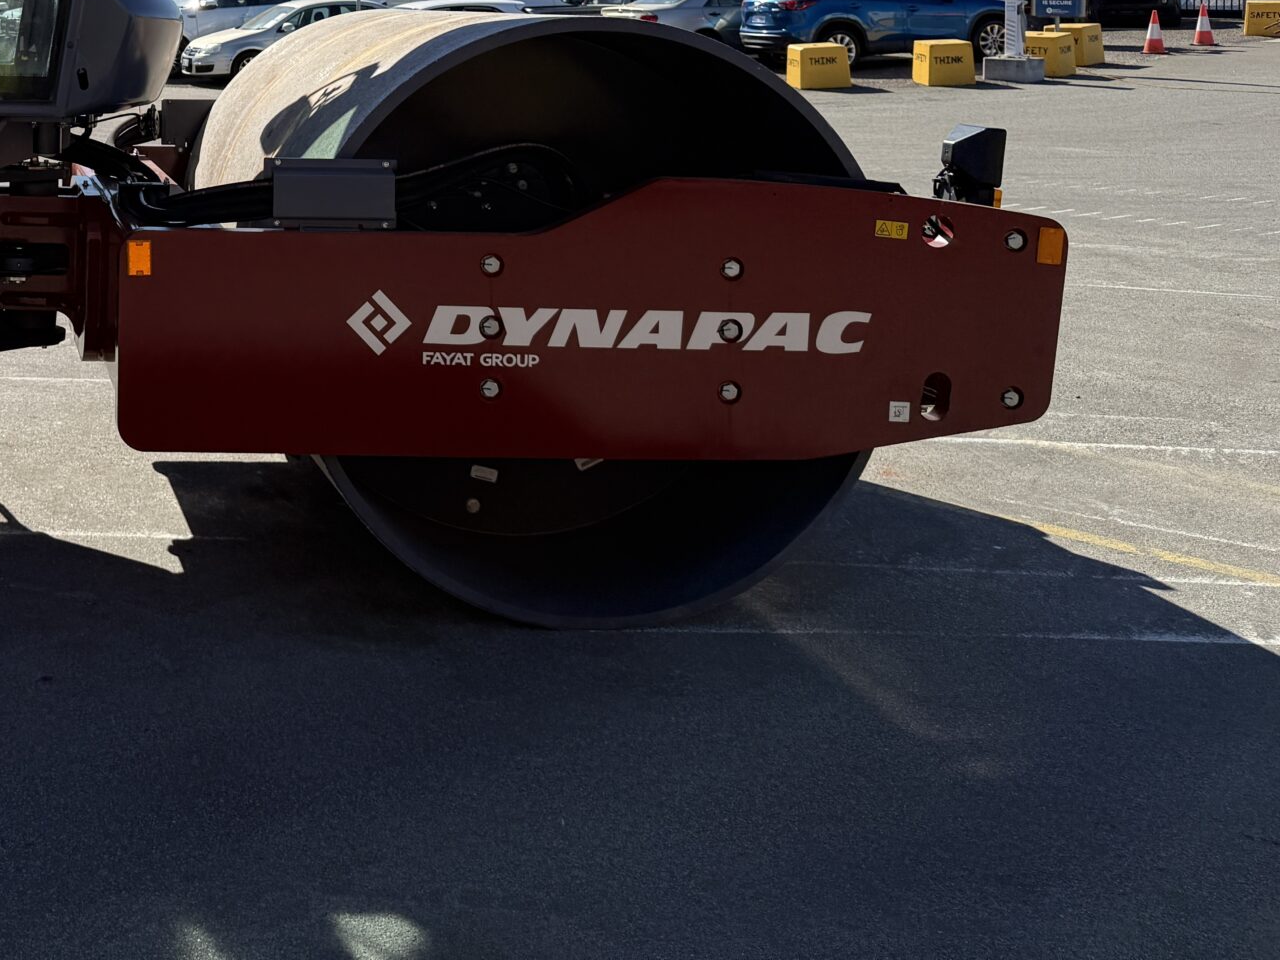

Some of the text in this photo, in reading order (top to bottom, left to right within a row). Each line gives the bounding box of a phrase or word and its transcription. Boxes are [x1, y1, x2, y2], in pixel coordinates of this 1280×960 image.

[808, 56, 837, 66] THINK
[934, 55, 964, 65] THINK
[422, 305, 872, 354] DYNAPAC
[422, 352, 540, 368] FAYAT GROUP
